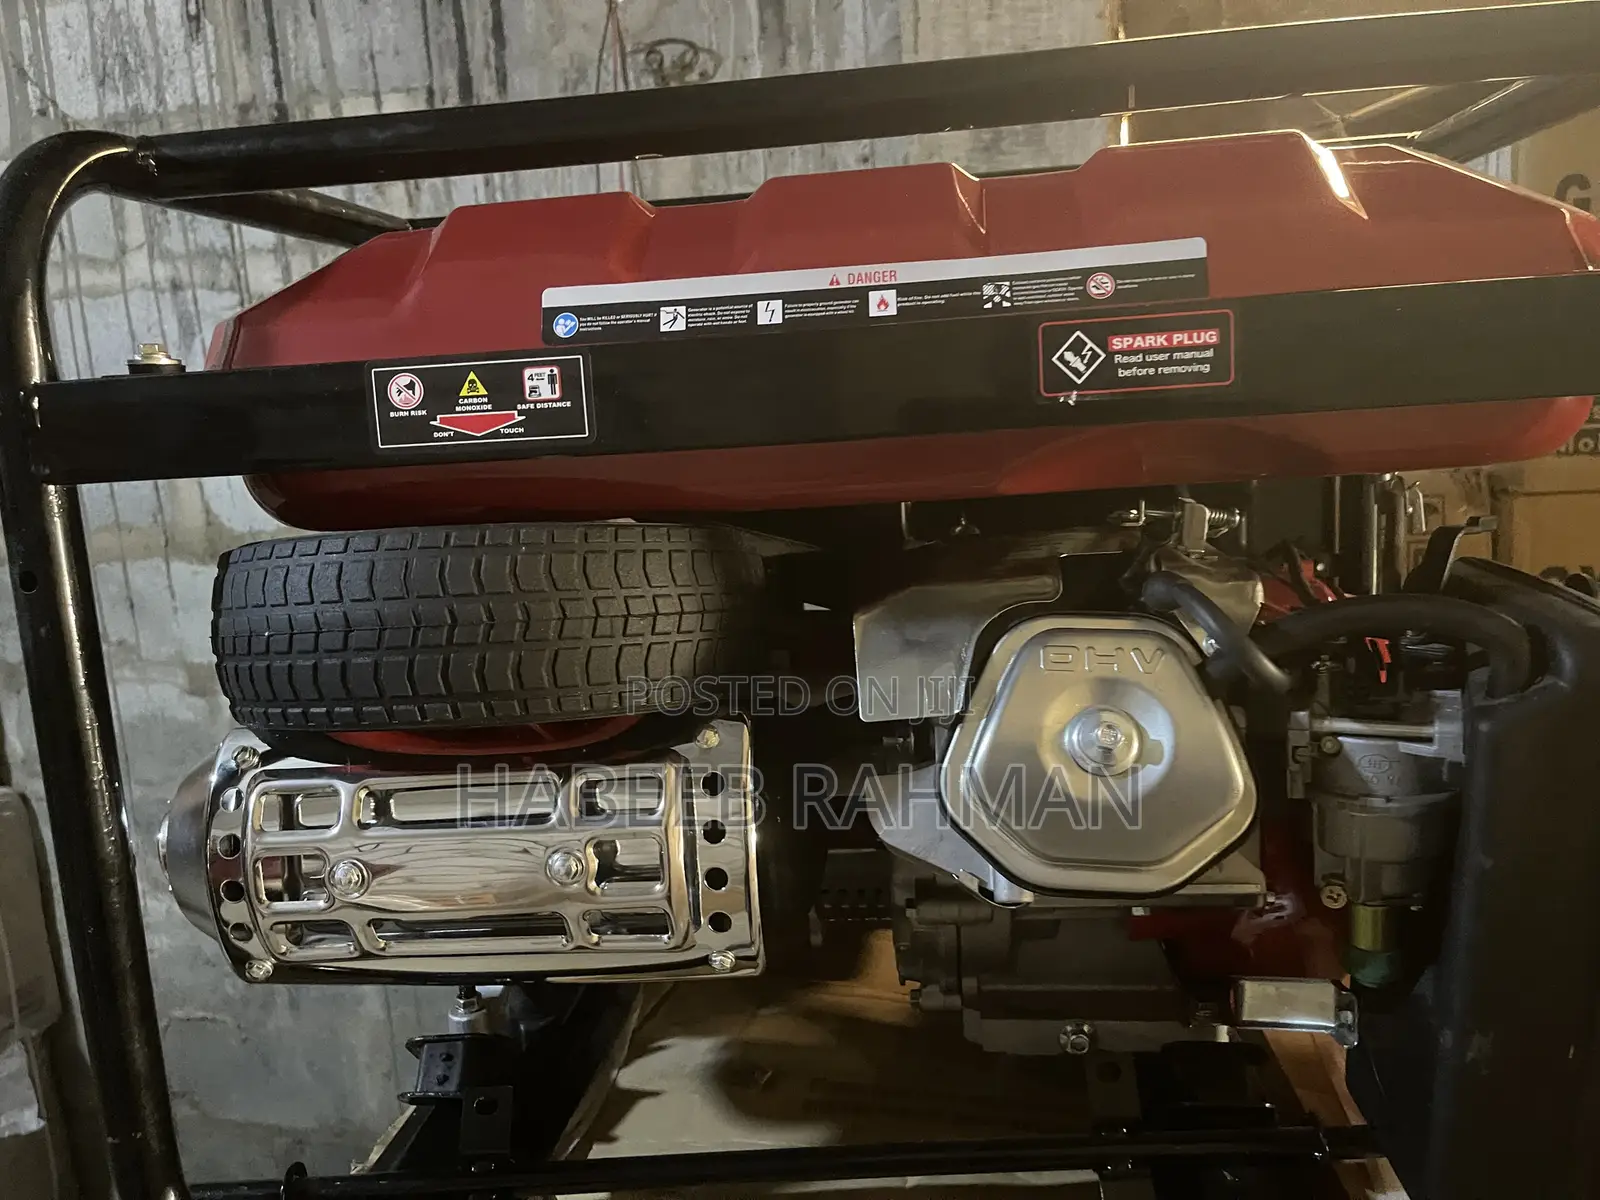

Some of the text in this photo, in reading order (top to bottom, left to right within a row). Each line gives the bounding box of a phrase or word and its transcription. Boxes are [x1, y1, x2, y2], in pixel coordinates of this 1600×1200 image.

[848, 270, 897, 284] DANGER
[1111, 331, 1218, 349] SPARK PLUG
[1114, 348, 1214, 364] Read user manual
[1118, 362, 1211, 377] before removing
[527, 374, 535, 382] 4
[1039, 644, 1164, 674] OHV
